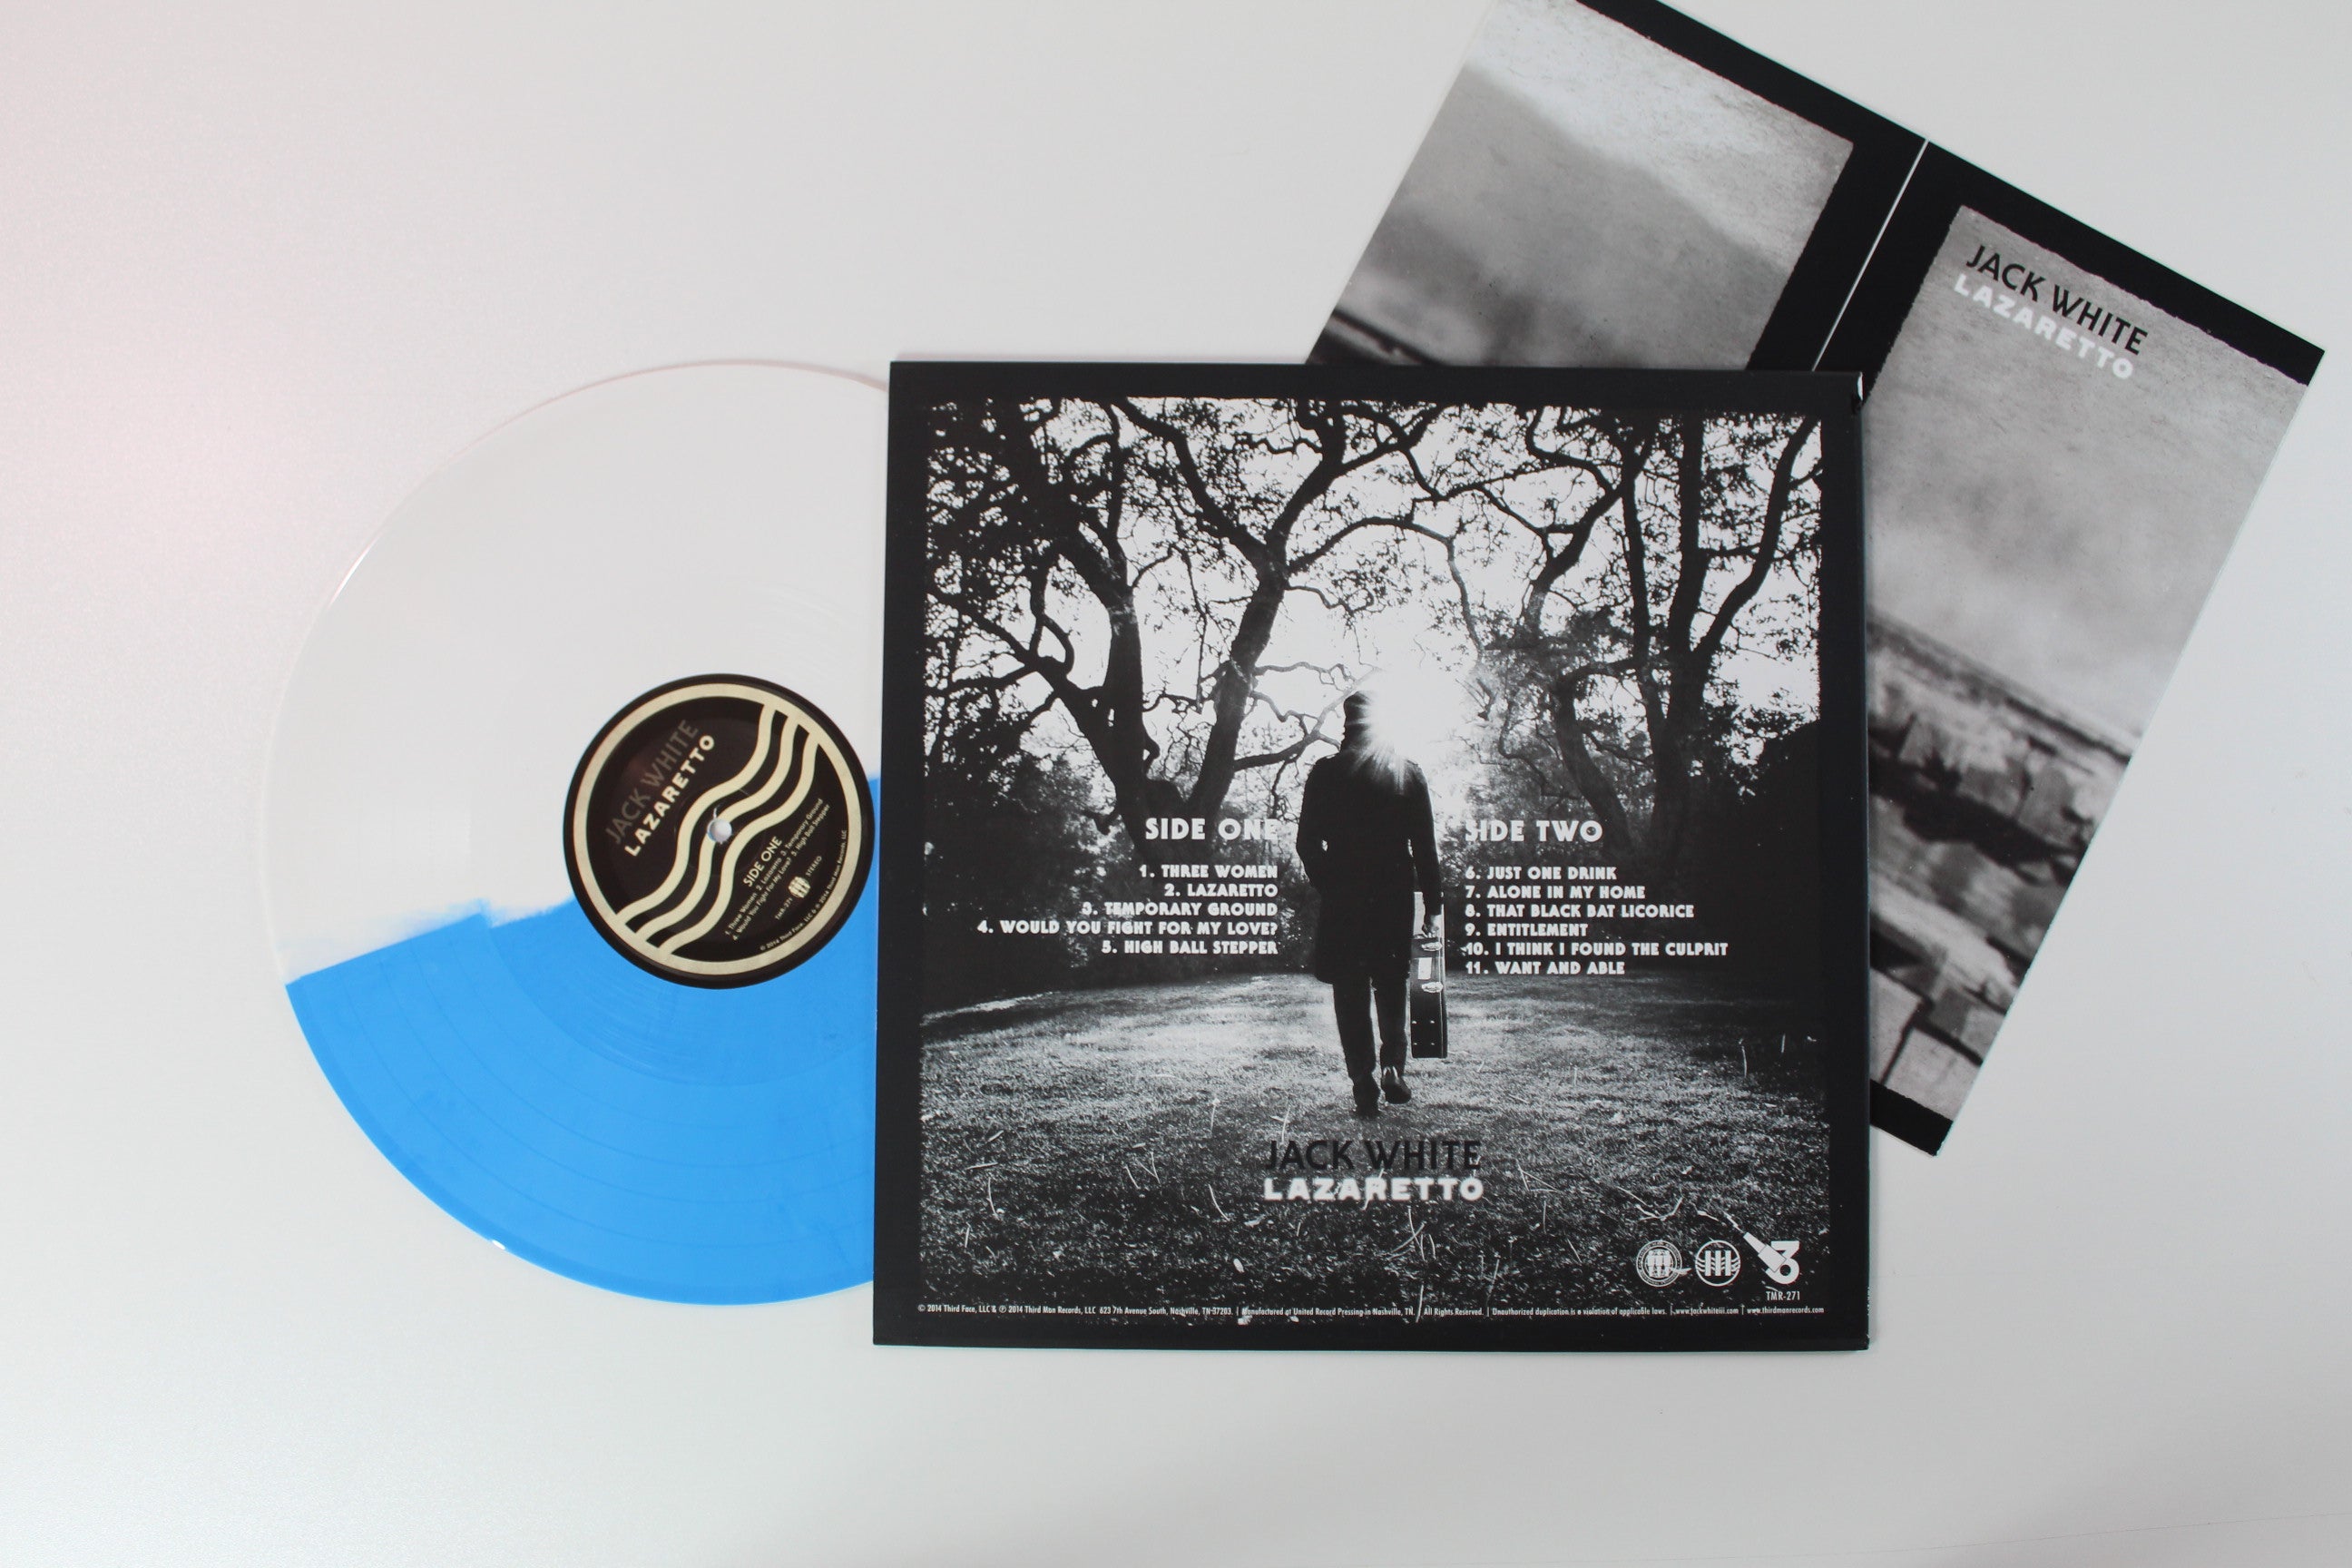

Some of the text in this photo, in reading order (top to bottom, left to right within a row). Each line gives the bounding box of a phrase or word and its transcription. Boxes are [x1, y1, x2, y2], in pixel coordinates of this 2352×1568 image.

[1965, 244, 2148, 356] JACK WHITE
[1953, 273, 2133, 379] LAZARETTO
[605, 719, 698, 845] JACK WHITE
[624, 734, 715, 857] LAZARETTO
[1145, 818, 1279, 840] SIDE ONE
[1465, 820, 1603, 842] SIDE TWO
[728, 912, 742, 930] Three
[739, 891, 758, 914] Women
[760, 856, 782, 884] Lazaretto
[784, 818, 809, 850] Temporary
[804, 797, 823, 820] Ground
[735, 915, 751, 934] Would
[748, 903, 760, 916] You
[755, 889, 769, 906] Fight
[765, 881, 775, 892] For
[771, 872, 781, 884] My
[794, 835, 808, 850] High
[803, 824, 815, 837] Ball
[811, 802, 831, 827] Stepper
[742, 835, 782, 887] SIDE ONE
[805, 854, 822, 877] STEREO
[1139, 865, 1278, 878] 1. THREE WOMEN
[1465, 867, 1617, 880] 6. JUST ONE DRINK
[1164, 884, 1278, 897] 2. LAZARETTO
[1465, 886, 1646, 899] 7. ALONE IN MY HOME
[1083, 902, 1278, 916] 3. TEMPORARY GROUND
[1465, 905, 1694, 918] 8. THAT BLACK BAT LICORICE
[977, 921, 1278, 935] 4. WOULD YOU FIGHT FOR MY LOVE?
[1465, 924, 1588, 937] 9. ENTITLEMENT
[1102, 940, 1279, 954] 5. HIGH BALL STEPPER
[1465, 943, 1729, 956] 10. I THINK I FOUND THE CULPRIT
[1465, 961, 1625, 975] 11. WANT AND ABLE
[1265, 1140, 1481, 1171] JACK WHITE
[1263, 1178, 1484, 1201] LAZARETTO
[1766, 1291, 1800, 1301] TMR-271
[926, 1304, 942, 1313] 2014
[943, 1304, 960, 1313] Third
[961, 1305, 977, 1314] Face,
[978, 1305, 990, 1313] LLC
[991, 1305, 996, 1313] &
[1008, 1305, 1024, 1314] 2014
[1024, 1305, 1041, 1314] Third
[1044, 1306, 1056, 1314] Man
[1057, 1306, 1083, 1315] Records,
[1084, 1306, 1096, 1315] LLC
[1099, 1306, 1111, 1315] 623
[1112, 1306, 1123, 1315] 7th
[1124, 1306, 1147, 1315] Avenue
[1148, 1306, 1168, 1316] South,
[1170, 1307, 1200, 1316] Nashville,
[1241, 1307, 1284, 1316] Manufactured
[1285, 1308, 1292, 1316] at
[1293, 1307, 1314, 1316] United
[1316, 1307, 1337, 1316] Record
[1338, 1307, 1363, 1317] Pressing
[1365, 1308, 1371, 1316] in
[1372, 1307, 1403, 1317] Nashville,
[1405, 1308, 1416, 1316] TN.
[1424, 1307, 1433, 1316] All
[1434, 1307, 1454, 1317] Rights
[1455, 1307, 1485, 1316] Reserved.
[1492, 1307, 1534, 1316] Unauthorized
[1535, 1307, 1570, 1317] duplication
[1571, 1308, 1576, 1316] is
[1583, 1307, 1610, 1316] violation
[1611, 1307, 1618, 1316] of
[1619, 1307, 1651, 1317] applicable
[1651, 1307, 1667, 1316] laws.
[1747, 1306, 1825, 1315] www.thirdmanrecords.com
